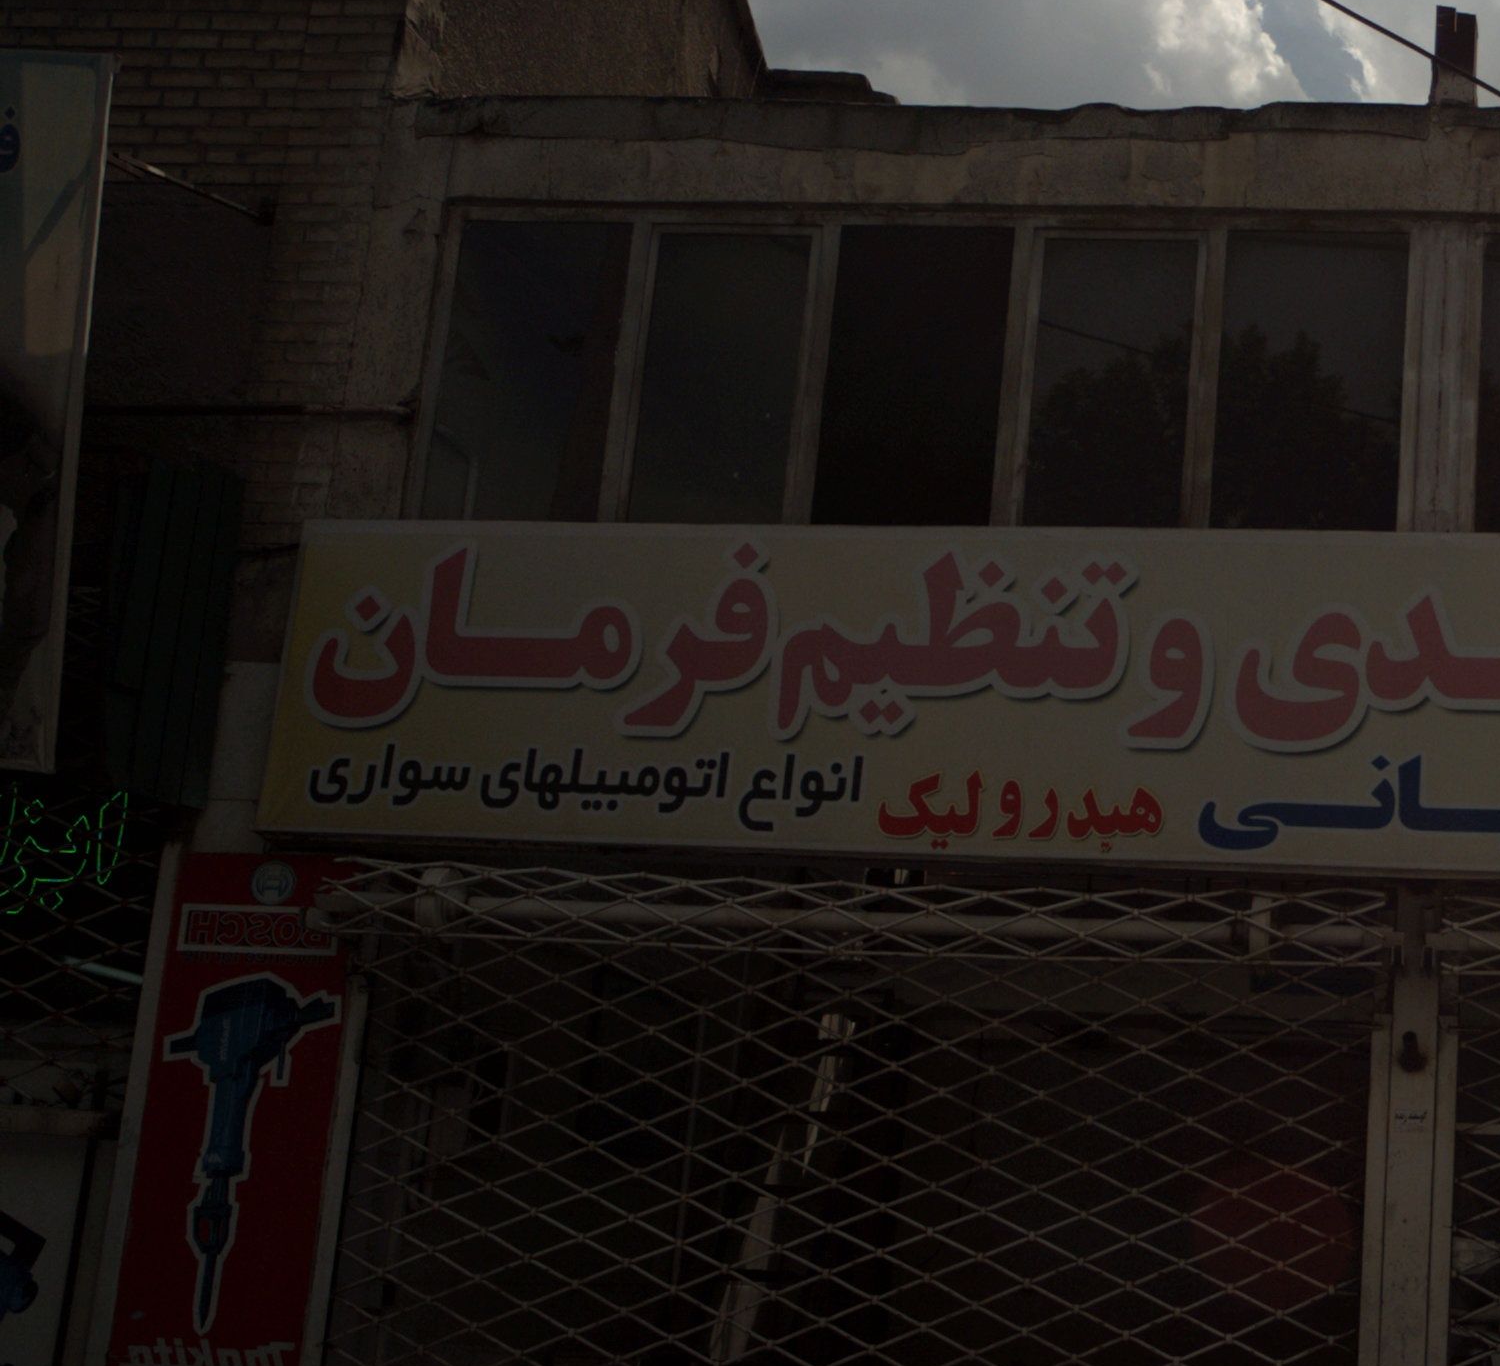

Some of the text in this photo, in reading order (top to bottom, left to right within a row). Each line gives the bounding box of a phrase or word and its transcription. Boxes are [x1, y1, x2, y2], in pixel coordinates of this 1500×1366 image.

[311, 542, 771, 728] فرمان
[776, 549, 1127, 732] تنظیم
[1126, 617, 1202, 740] و
[309, 743, 472, 806] سواری
[480, 748, 731, 814] اتومبیلهای
[738, 754, 864, 832] انواع
